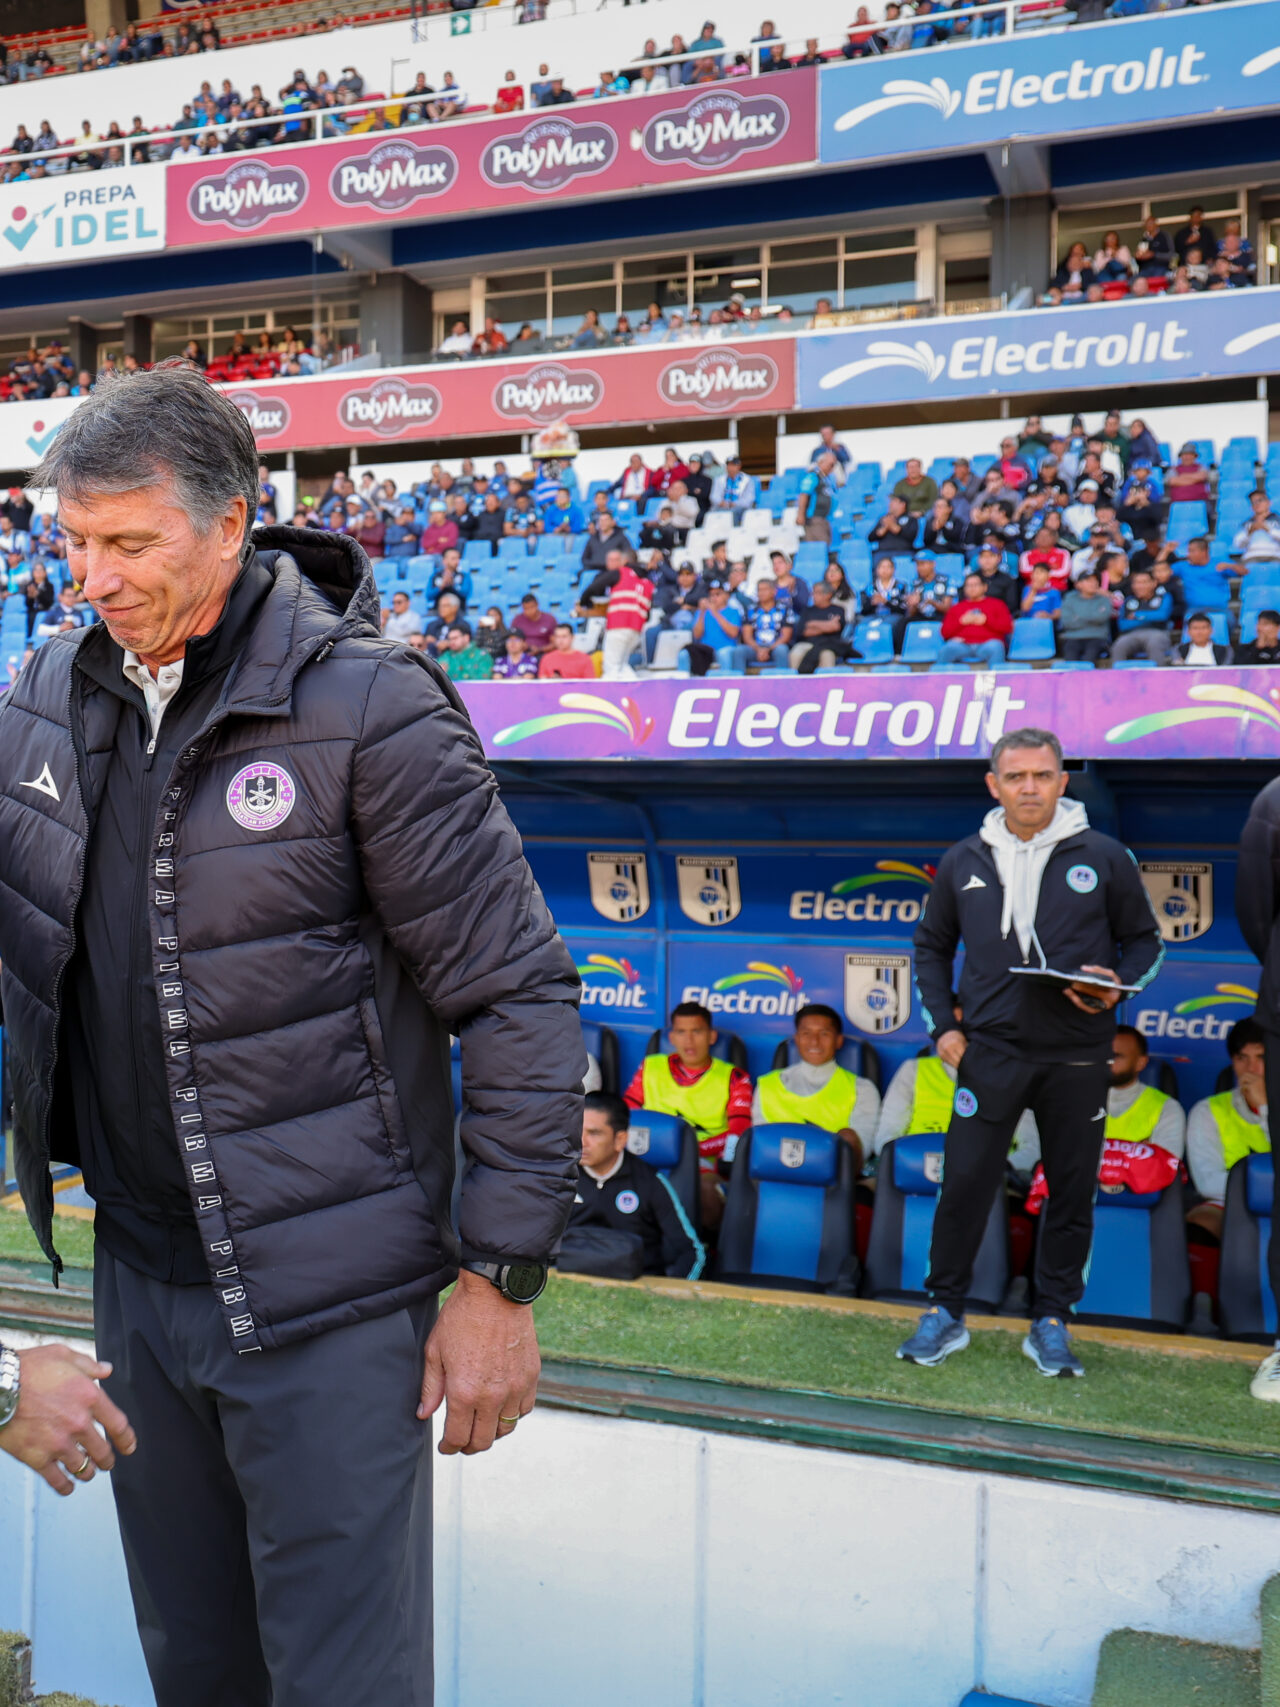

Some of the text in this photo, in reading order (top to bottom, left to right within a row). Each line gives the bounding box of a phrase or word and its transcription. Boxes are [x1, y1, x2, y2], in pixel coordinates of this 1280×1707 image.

[963, 44, 1206, 116] Electrolit
[655, 111, 776, 154] PolyMax
[492, 137, 605, 177] PolyMax
[64, 184, 136, 207] PREPA
[198, 178, 299, 217] PolyMax
[340, 160, 448, 198] PolyMax
[55, 207, 158, 247] IDEL
[947, 321, 1188, 380] Electrolit
[502, 381, 594, 412] PolyMax
[670, 366, 768, 398] PolyMax
[347, 393, 432, 424] PolyMax
[667, 684, 1025, 748] Electrolit
[789, 891, 928, 923] Electrol
[580, 982, 646, 1008] trolit
[1136, 1009, 1235, 1041] Electr
[158, 936, 190, 1058] PIRMA
[176, 1087, 222, 1210] PIRMA
[211, 1239, 261, 1355] PIRM
